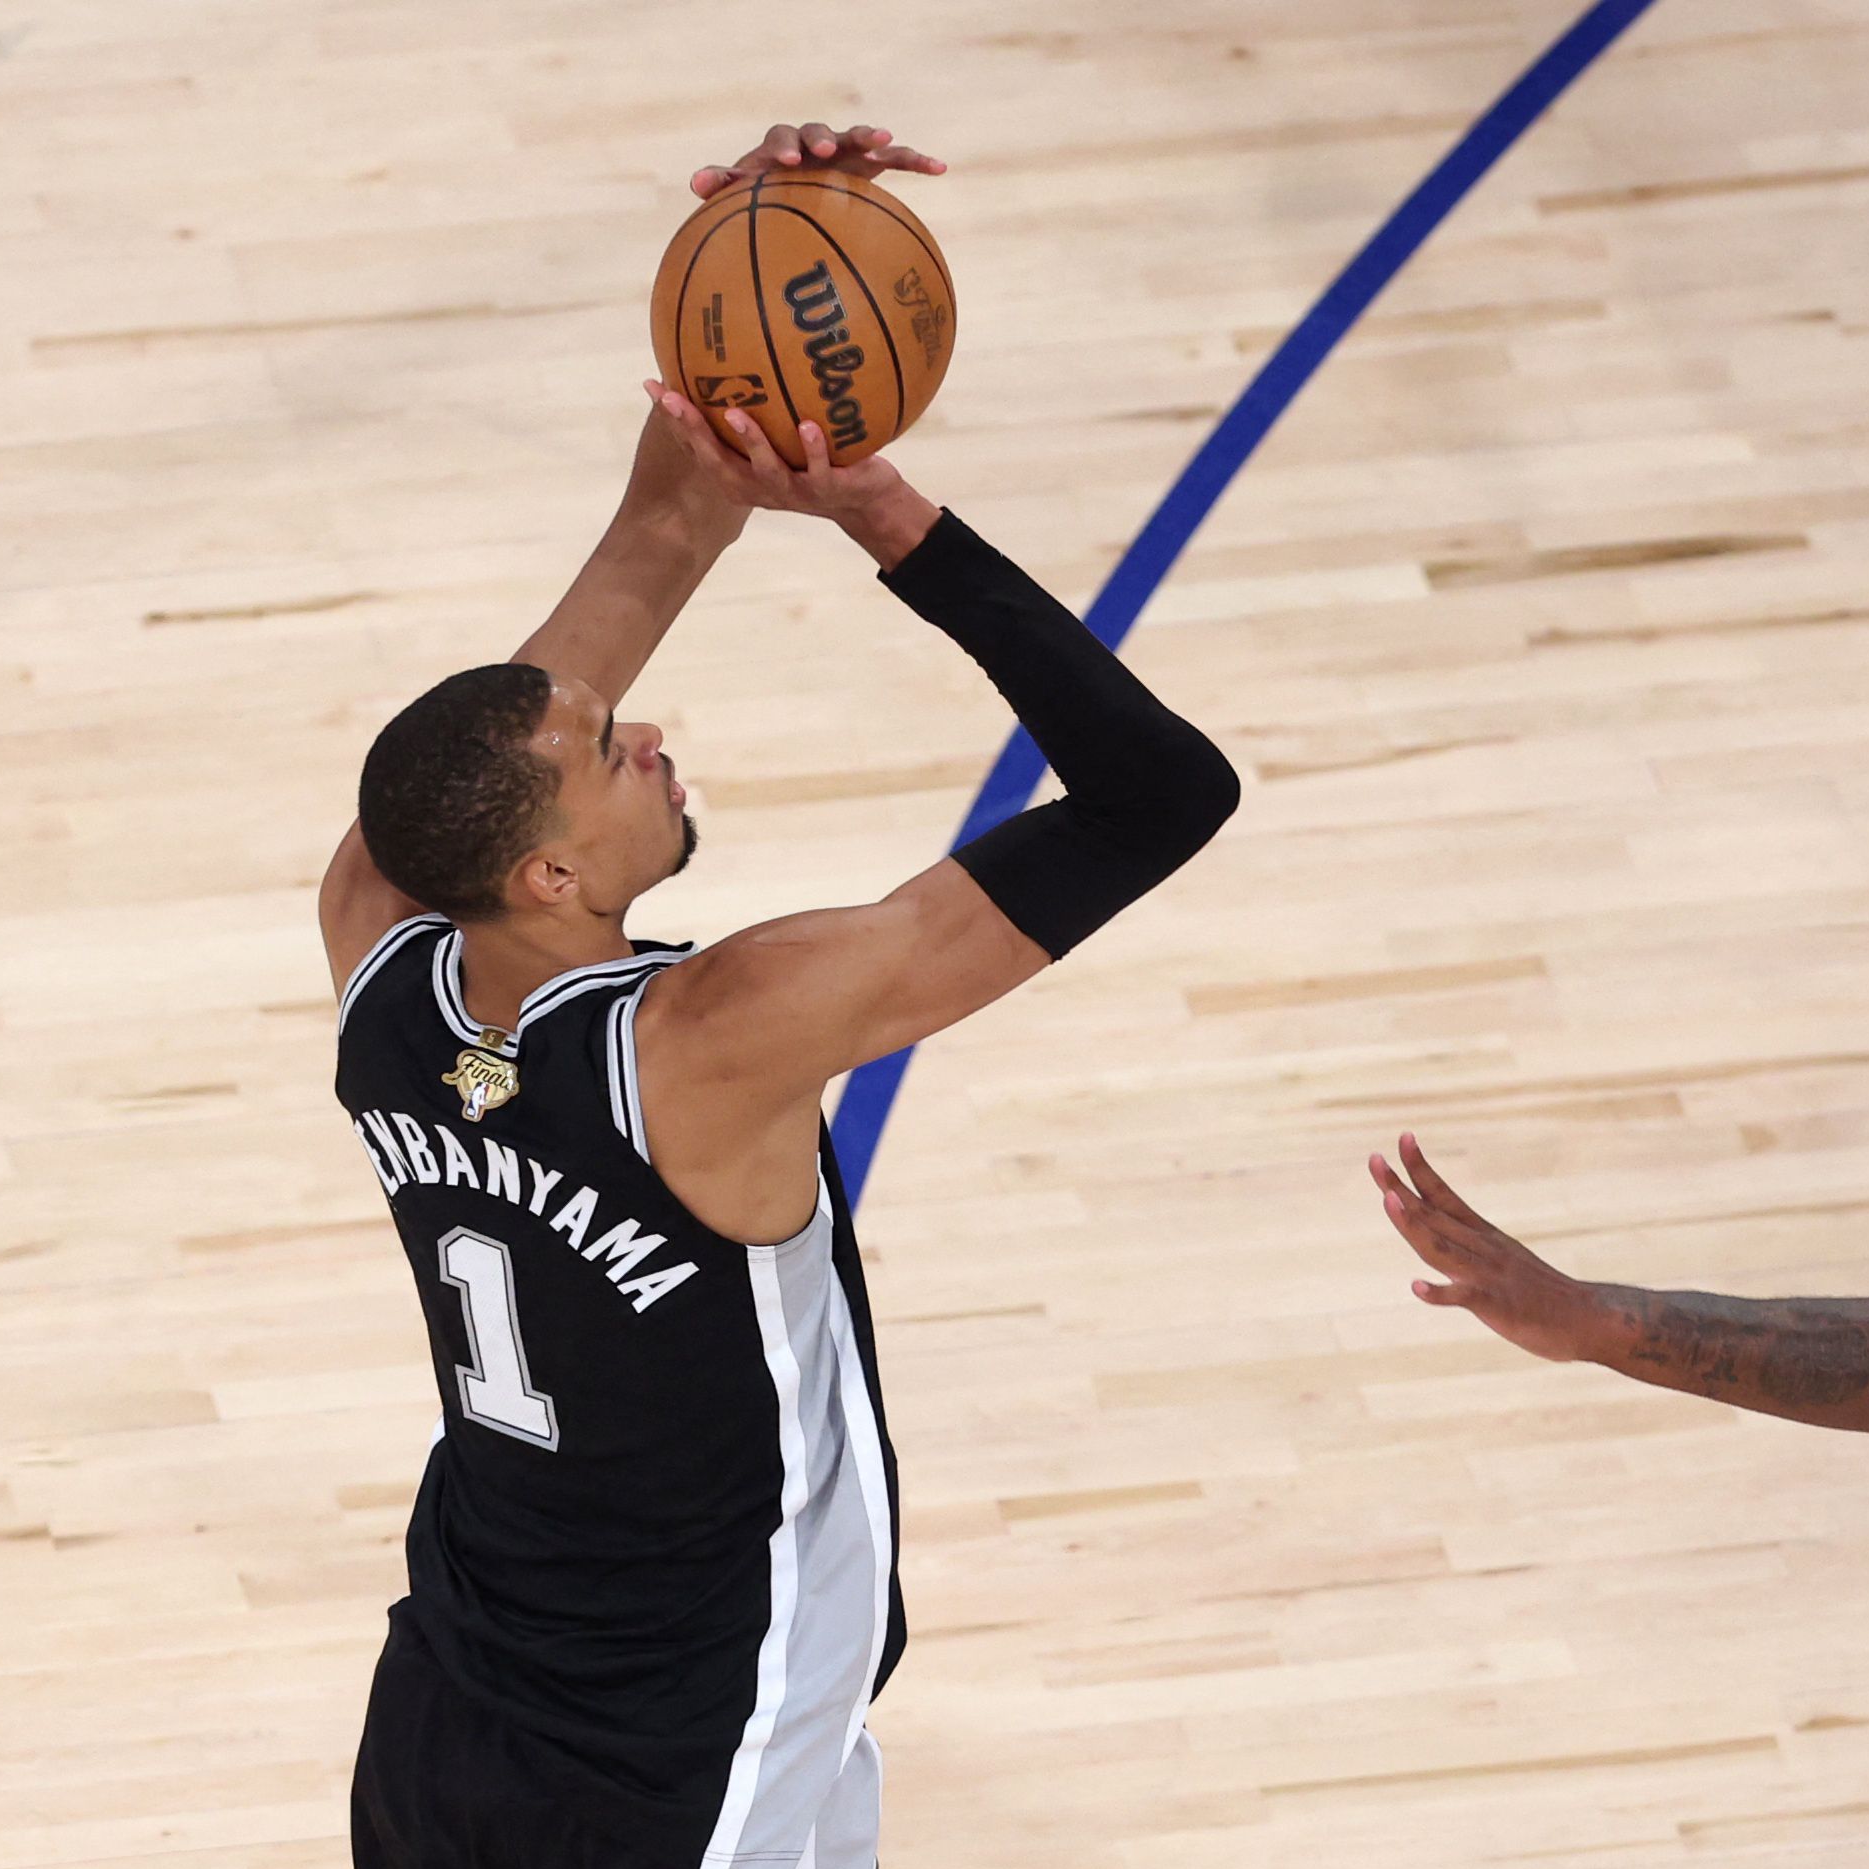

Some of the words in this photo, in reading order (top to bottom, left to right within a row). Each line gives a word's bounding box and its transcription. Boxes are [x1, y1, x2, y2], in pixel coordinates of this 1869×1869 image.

[782, 258, 869, 451] Wilson
[354, 1109, 700, 1314] EMBANYAMA
[437, 1225, 560, 1453] 1
